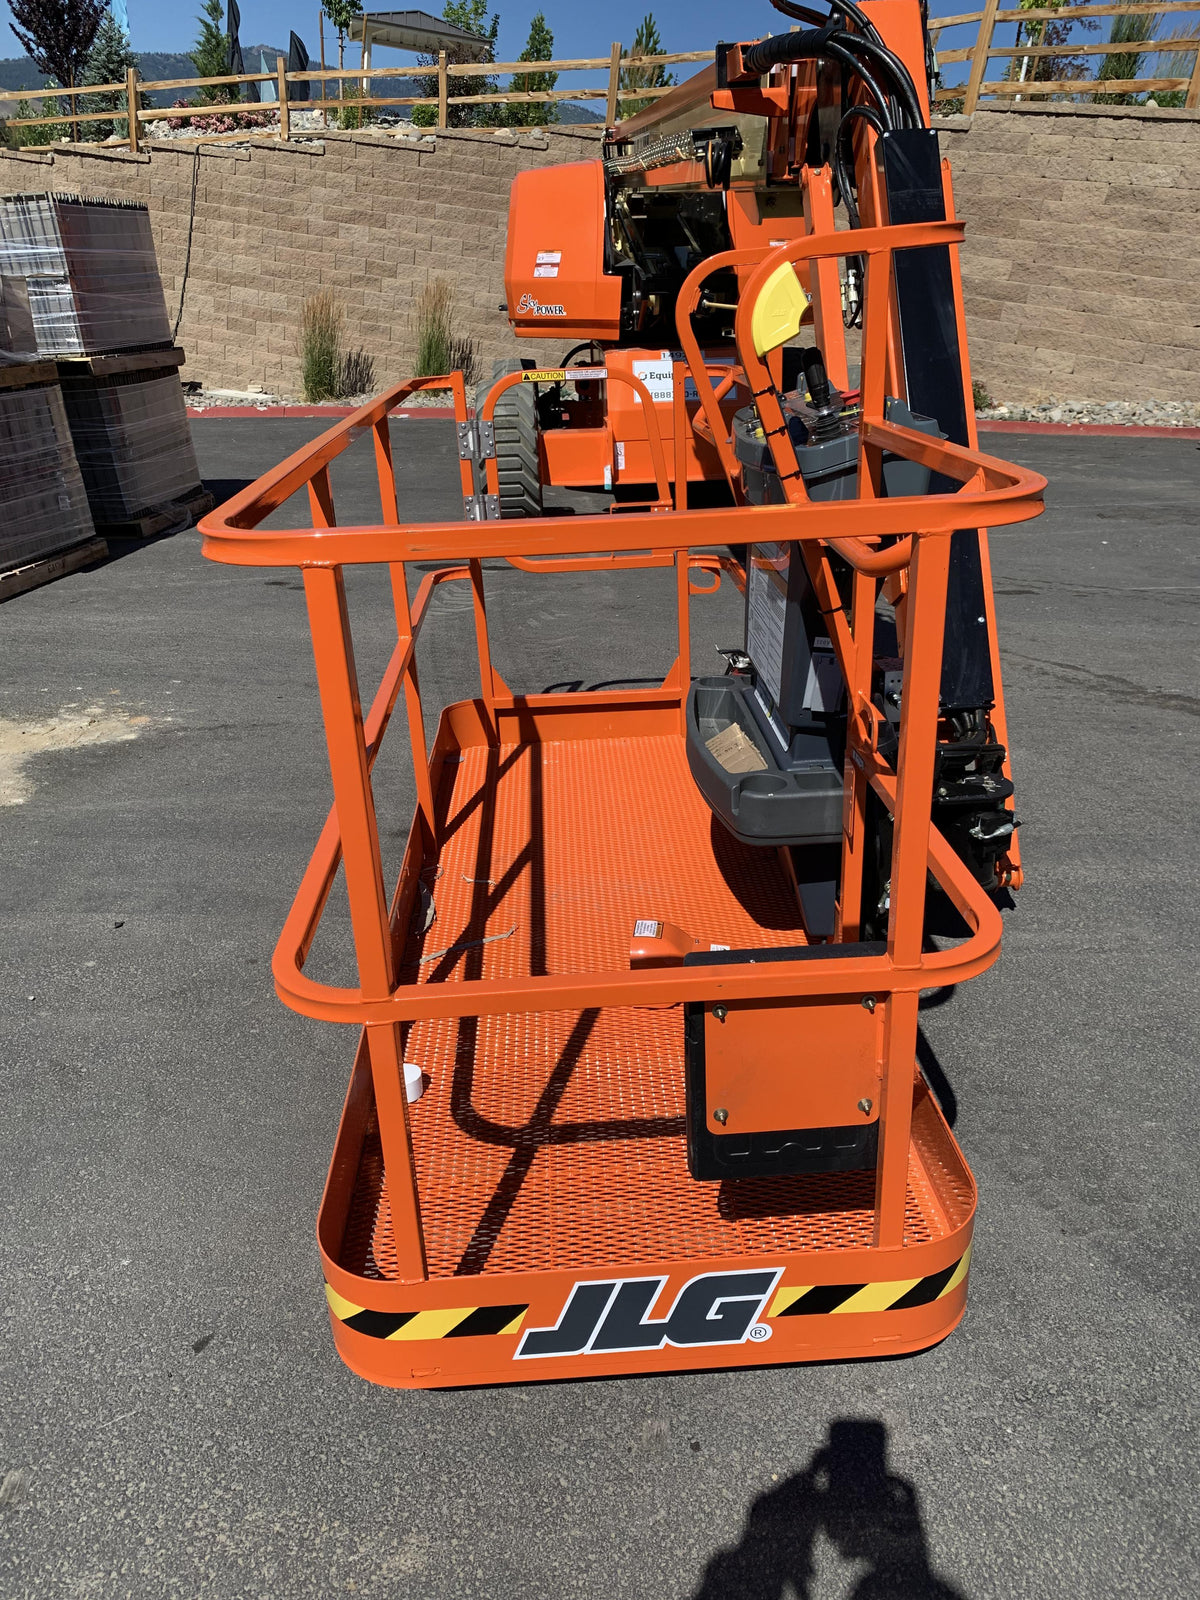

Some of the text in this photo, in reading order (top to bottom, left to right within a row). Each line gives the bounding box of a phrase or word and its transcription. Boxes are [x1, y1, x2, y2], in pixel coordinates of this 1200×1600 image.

[536, 305, 564, 315] POWER
[530, 372, 564, 380] CAUTION
[513, 1267, 786, 1360] JLG
